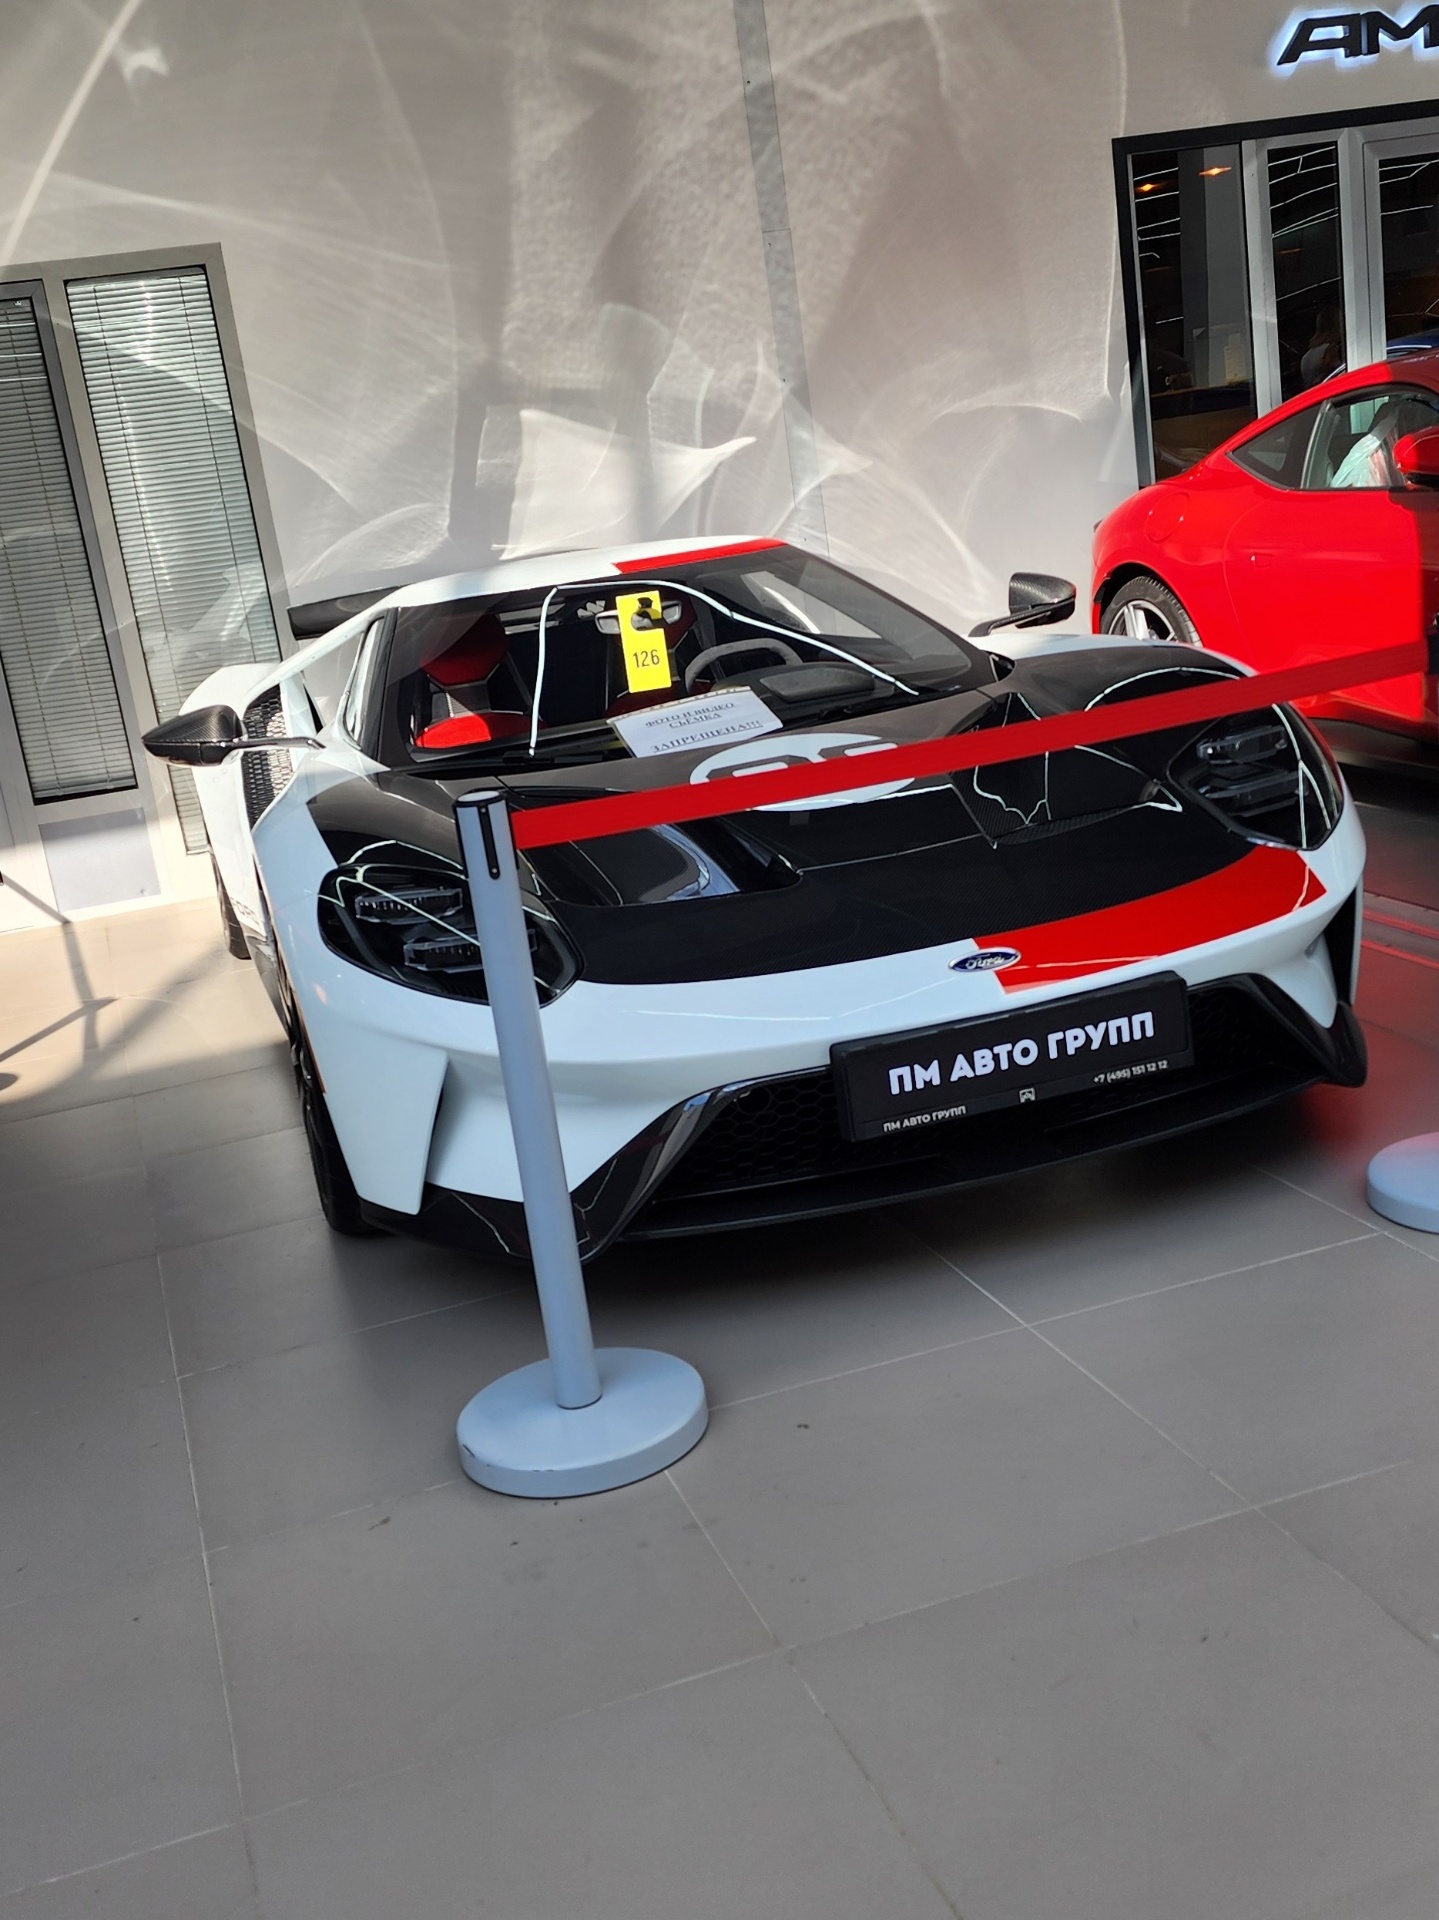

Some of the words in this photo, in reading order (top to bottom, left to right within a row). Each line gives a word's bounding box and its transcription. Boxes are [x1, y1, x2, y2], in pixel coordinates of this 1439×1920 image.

[633, 649, 660, 668] 126
[645, 713, 679, 728] ФОТО
[682, 710, 692, 718] И
[694, 702, 734, 716] ВИДЕО
[965, 953, 1005, 970] Ford
[888, 1058, 941, 1096] ПМ
[949, 1038, 1039, 1083] АВТО
[1047, 1011, 1155, 1060] ГРУПП
[1093, 1073, 1105, 1083] +7
[1106, 1067, 1131, 1083] (495)
[883, 1120, 901, 1132] ПМ
[902, 1113, 931, 1128] АВТО
[931, 1105, 967, 1121] ГРУПП
